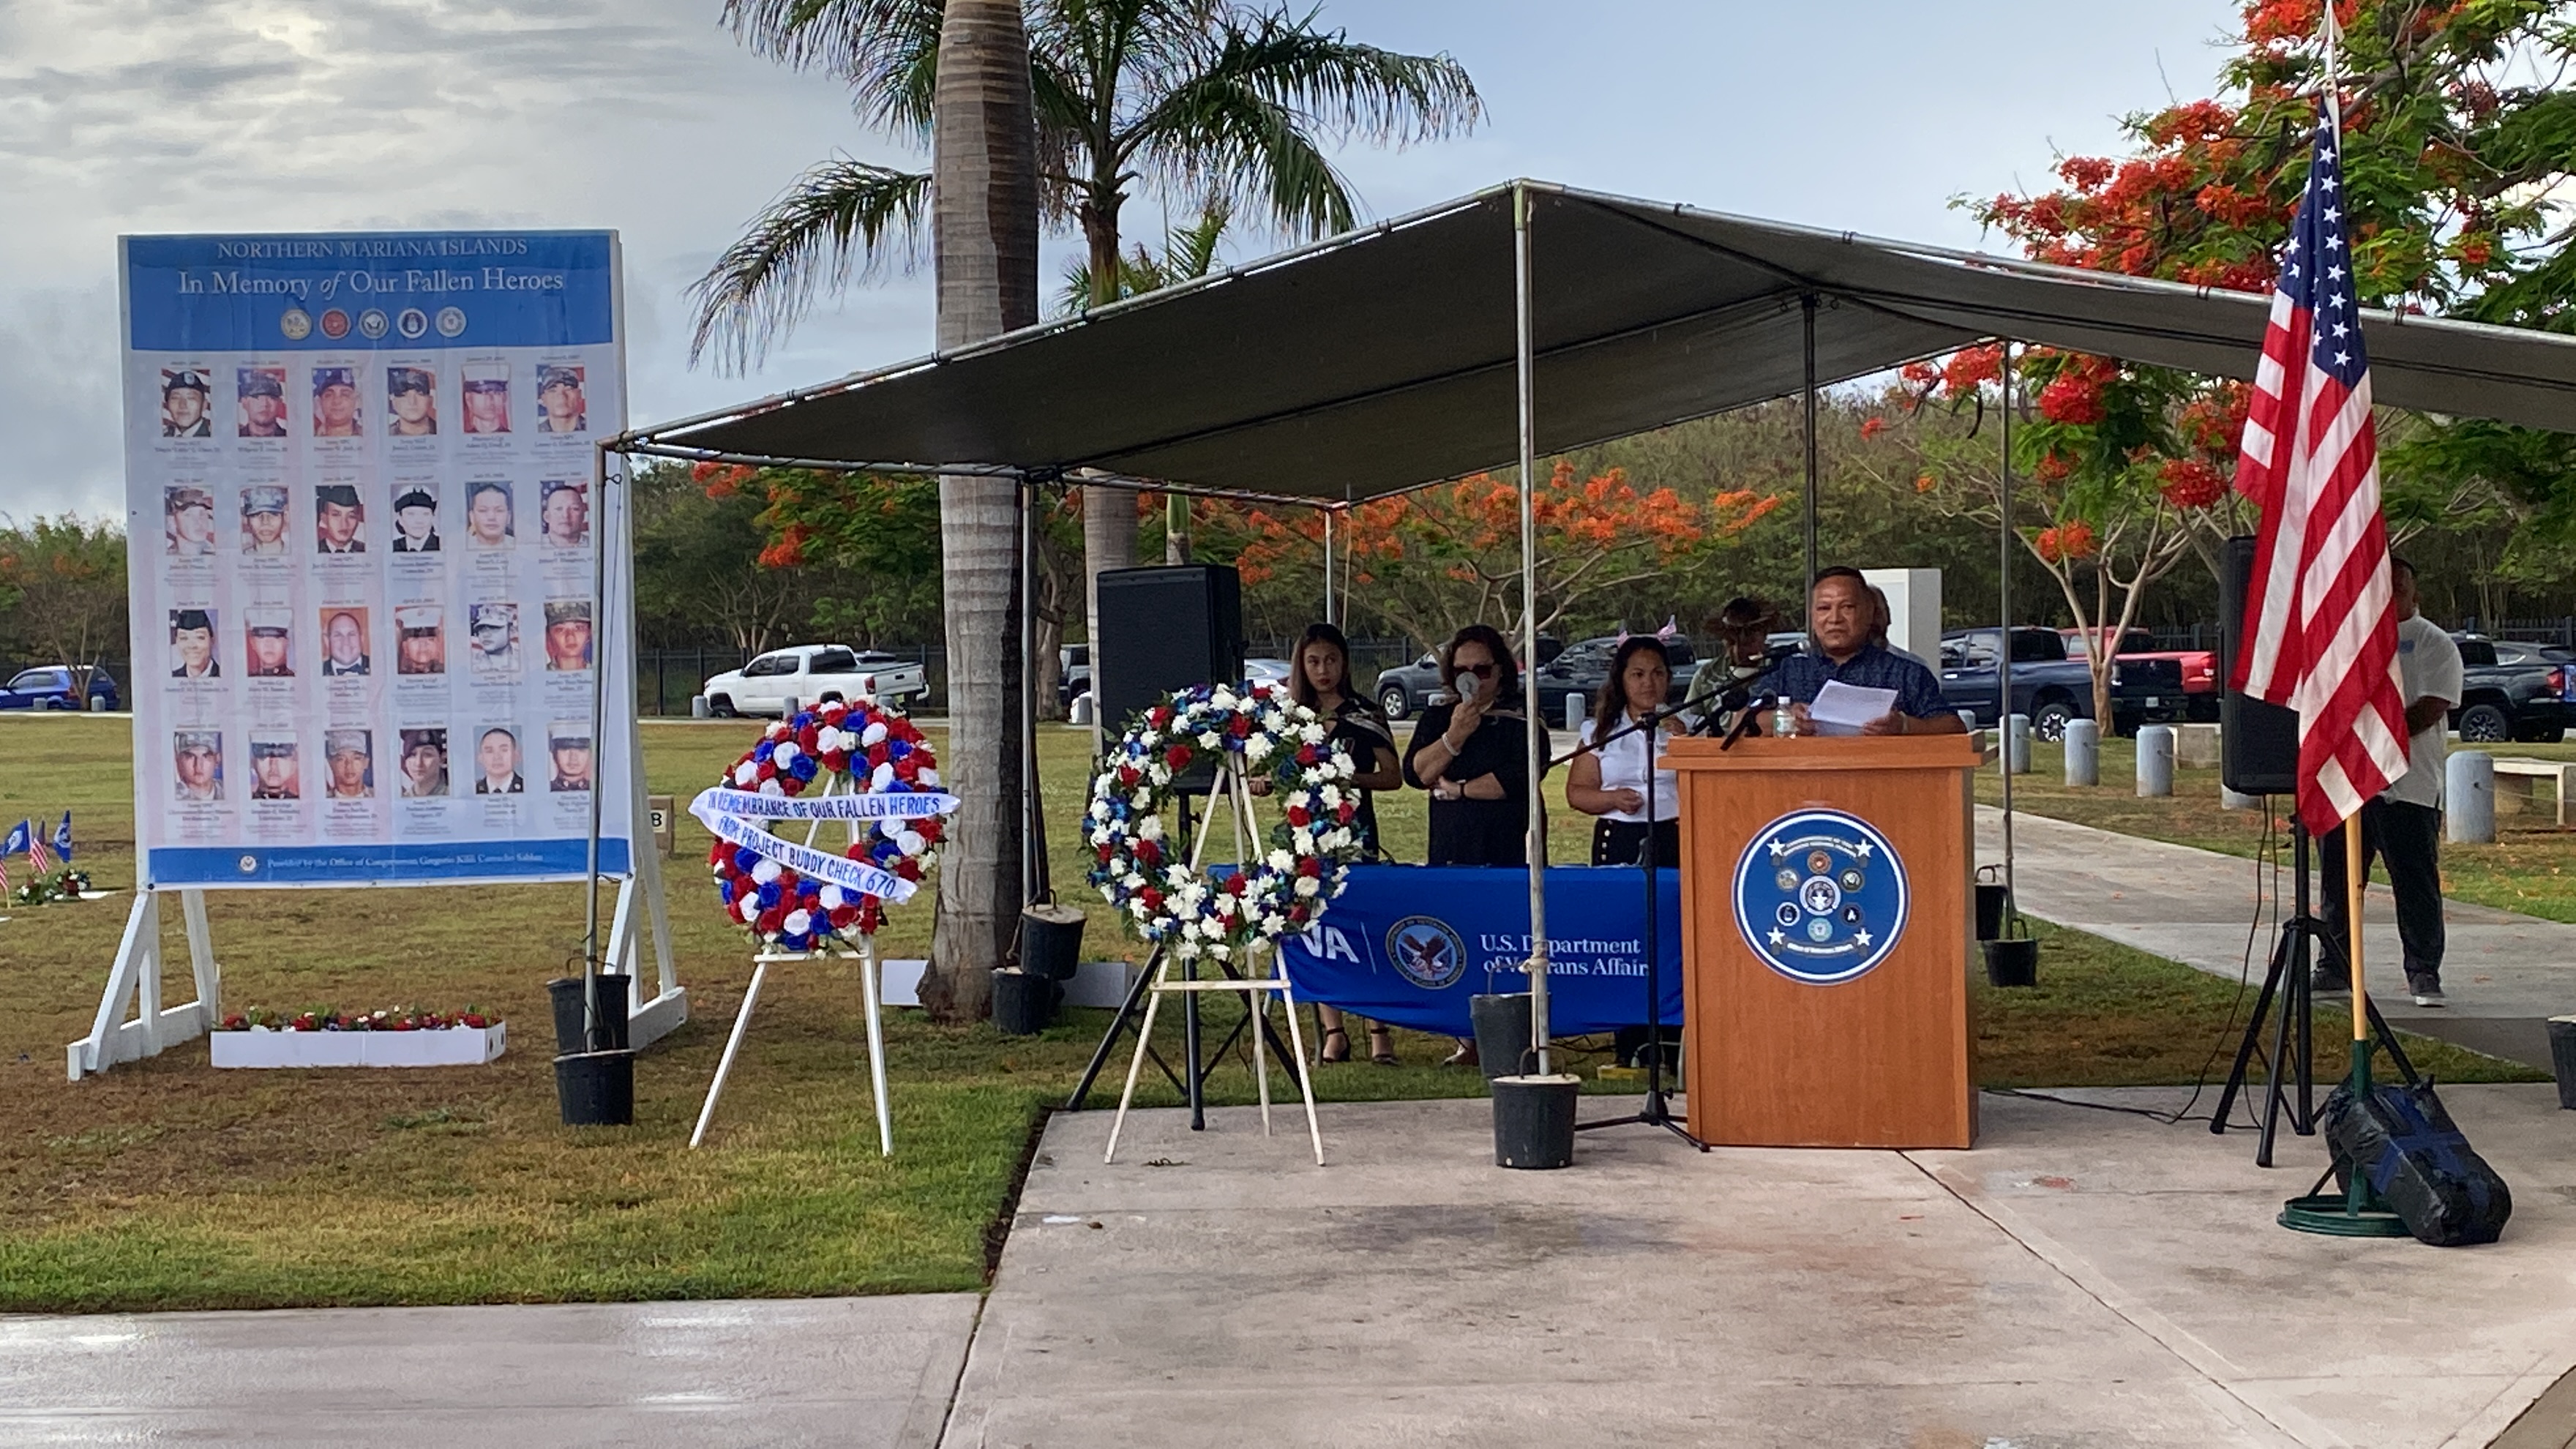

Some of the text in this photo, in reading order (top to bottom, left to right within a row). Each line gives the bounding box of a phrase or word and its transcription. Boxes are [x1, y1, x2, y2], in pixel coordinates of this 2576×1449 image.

[217, 239, 528, 258] NORTHERN MARIANA ISLANDS
[178, 266, 564, 301] In Memory of Our Fallen Heroes
[793, 801, 809, 817] OF
[809, 801, 836, 818] OUR
[836, 797, 886, 818] FALLEN
[889, 797, 940, 815] HEROES
[741, 827, 785, 861] PROJECT
[788, 847, 825, 876] BUDDY
[827, 859, 866, 889] CHECK
[866, 871, 897, 897] 670
[1300, 924, 1360, 963] VA
[1480, 934, 1518, 952] U.S.
[1522, 935, 1641, 957] Dpartment
[1483, 956, 1502, 973] of
[1505, 956, 1589, 976] Vrans
[1592, 958, 1650, 976] Affair
